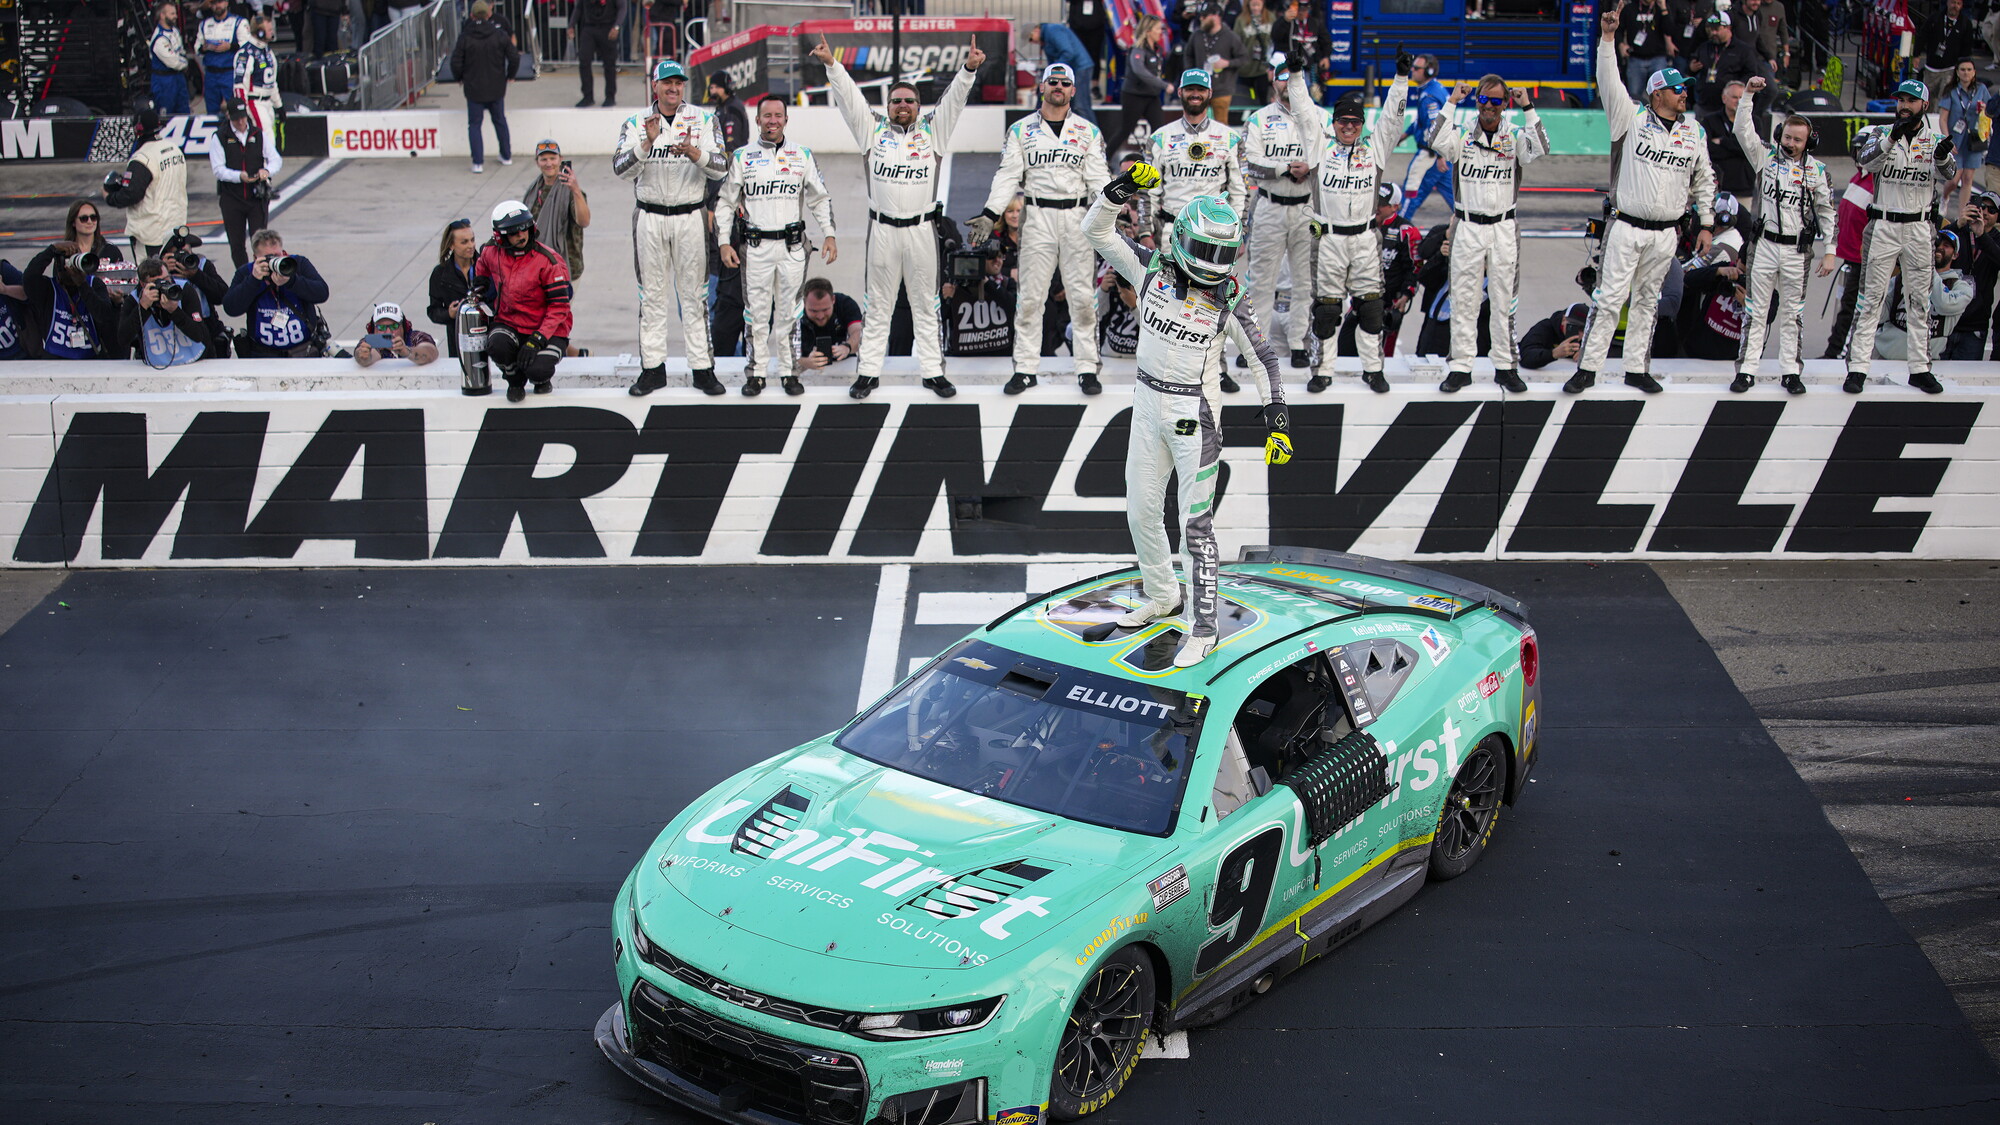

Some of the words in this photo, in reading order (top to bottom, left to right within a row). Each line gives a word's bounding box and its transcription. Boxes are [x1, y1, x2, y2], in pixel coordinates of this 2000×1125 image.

[854, 20, 875, 30] DO
[909, 19, 956, 30] ENTER
[0, 119, 54, 158] M
[160, 115, 220, 154] 45
[346, 129, 399, 151] COOK
[402, 128, 438, 150] OUT
[1028, 149, 1085, 166] UniFirst
[1265, 143, 1303, 157] UniFi
[1635, 141, 1692, 168] UniFirst
[873, 161, 929, 179] UniFirst
[1170, 163, 1222, 178] UniFirst
[1322, 172, 1373, 190] UniFirst
[1461, 163, 1512, 179] UniFirst
[376, 304, 399, 316] PAPERCLIP
[957, 300, 1007, 331] 206
[260, 319, 304, 346] 538
[968, 326, 1009, 343] NASCAR
[1143, 307, 1209, 344] UniFirst
[1707, 317, 1741, 340] TEAM/DRIV
[959, 338, 1010, 351] PRODUCTIONS
[1174, 418, 1199, 436] 9
[1194, 535, 1217, 615] UniFirst
[1267, 567, 1343, 585] PARTS
[1341, 580, 1404, 597] AUTO
[1351, 625, 1376, 636] Kelley
[1377, 623, 1394, 633] Blue
[1247, 664, 1274, 685] CHASE
[1273, 647, 1305, 668] ELLIOTT
[1066, 684, 1176, 720] ELLIOTT
[1457, 689, 1479, 712] prime
[1290, 716, 1463, 868] Uirst
[1378, 805, 1431, 838] SOLUTIONS
[1333, 837, 1368, 868] SERVICES
[685, 799, 1053, 941] UniFirst
[657, 852, 746, 879] UNIFORMS
[766, 874, 855, 910] SERVICES
[876, 912, 990, 967] SOLUTIONS
[1193, 821, 1286, 978] 9
[810, 1055, 839, 1065] ZL1
[925, 1058, 964, 1072] Hendrick
